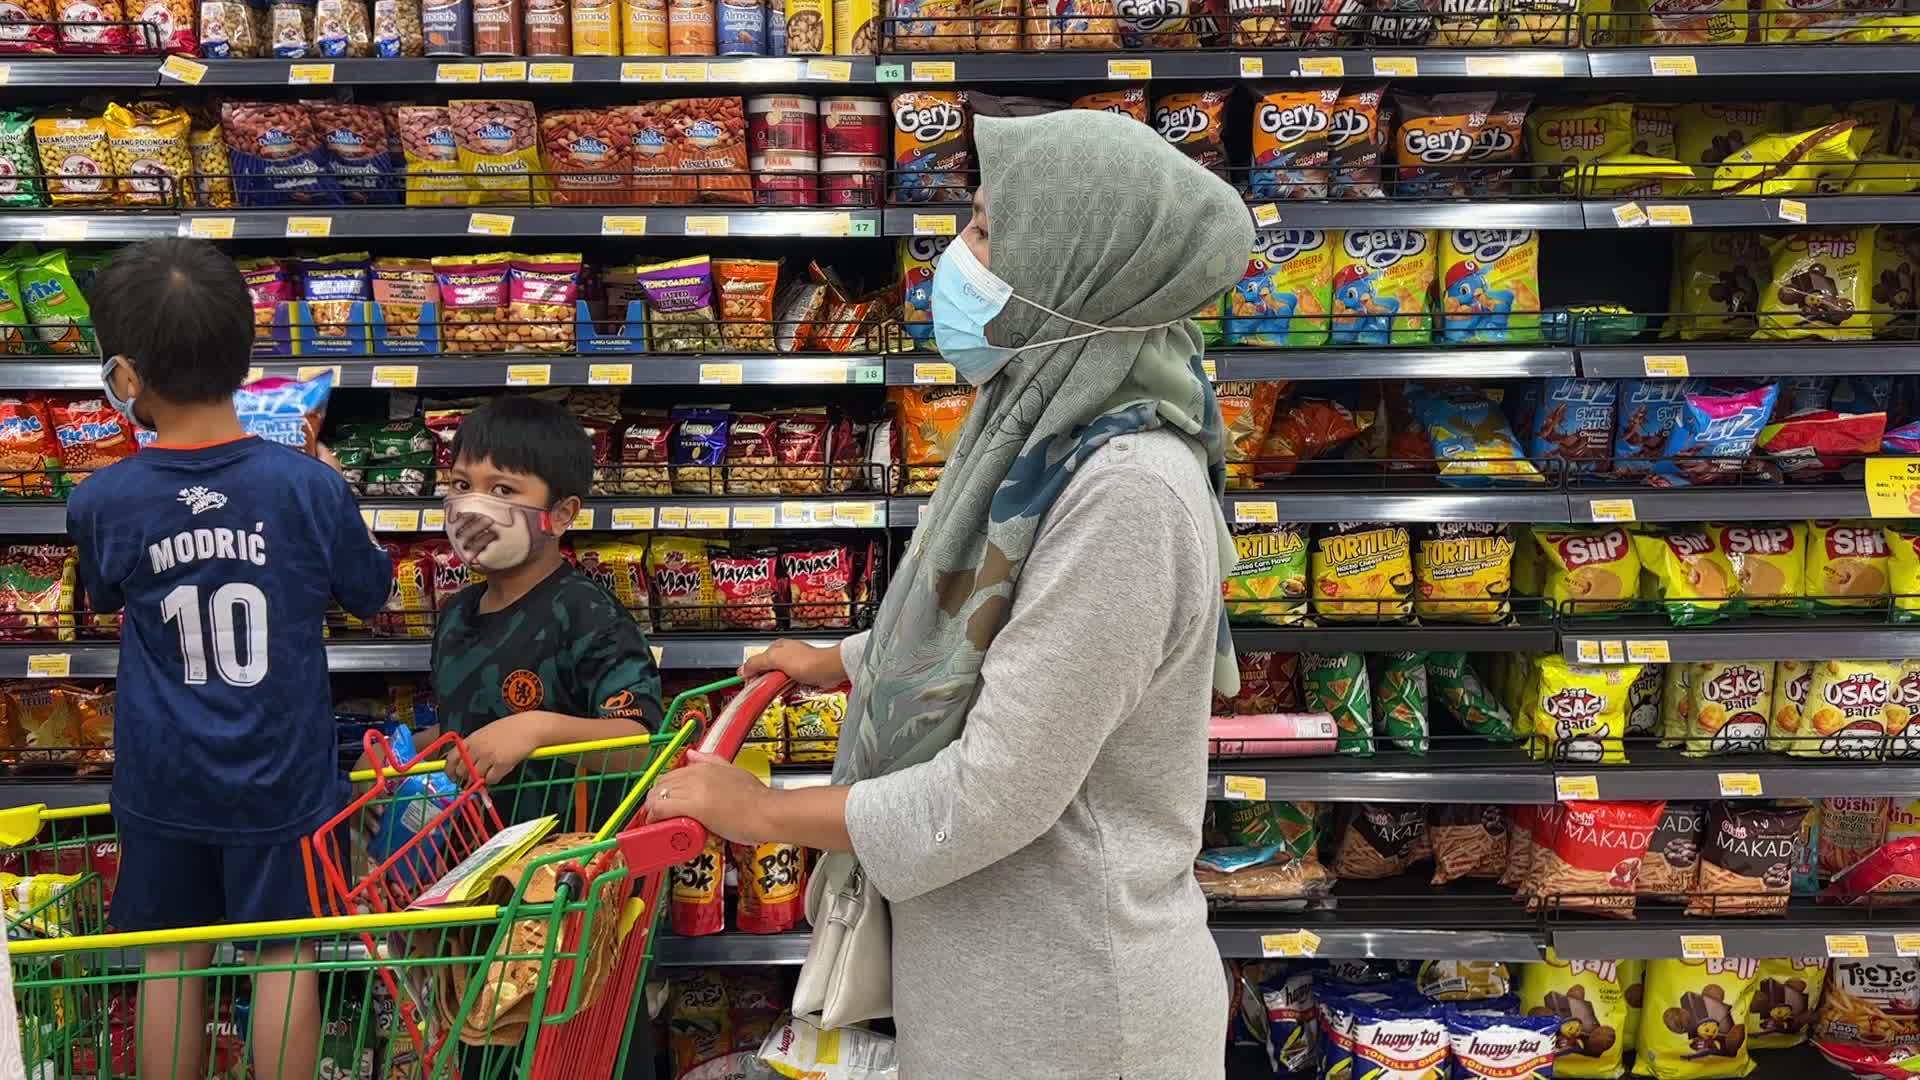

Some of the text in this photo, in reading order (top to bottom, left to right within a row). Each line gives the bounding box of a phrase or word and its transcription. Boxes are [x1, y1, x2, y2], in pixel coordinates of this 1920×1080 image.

[884, 69, 898, 78] 16
[895, 101, 962, 142] Gery
[1156, 101, 1209, 142] Gery
[1259, 105, 1328, 142] Gery
[1329, 109, 1370, 146] ery
[1405, 127, 1476, 162] Gery
[1560, 133, 1605, 151] Balls
[474, 160, 527, 174] Almonds
[679, 156, 736, 170] Mixed nuts
[855, 223, 869, 232] 17
[1343, 229, 1426, 268] Gery
[864, 370, 877, 379] 18
[1552, 378, 1621, 405] JETZ
[150, 521, 267, 574] MODRIĆ
[1235, 531, 1304, 561] RTILLA
[1320, 528, 1409, 567] TORTILLA
[1422, 535, 1511, 569] TORTILLA
[711, 558, 769, 585] Mayasi
[783, 551, 841, 577] Mayasi
[160, 582, 268, 687] 10
[1723, 696, 1759, 712] Balls
[1843, 705, 1882, 718] Balls
[1832, 797, 1875, 812] Oishi
[758, 848, 800, 875] POK
[758, 867, 800, 895] POK
[1571, 958, 1617, 983] Ball
[777, 1024, 796, 1056] happy
[1371, 1026, 1441, 1052] happy tos
[1468, 1036, 1542, 1061] happy tos
[1362, 1048, 1416, 1070] TORTILLA
[1460, 1055, 1548, 1077] TORTILLA CHIPS
